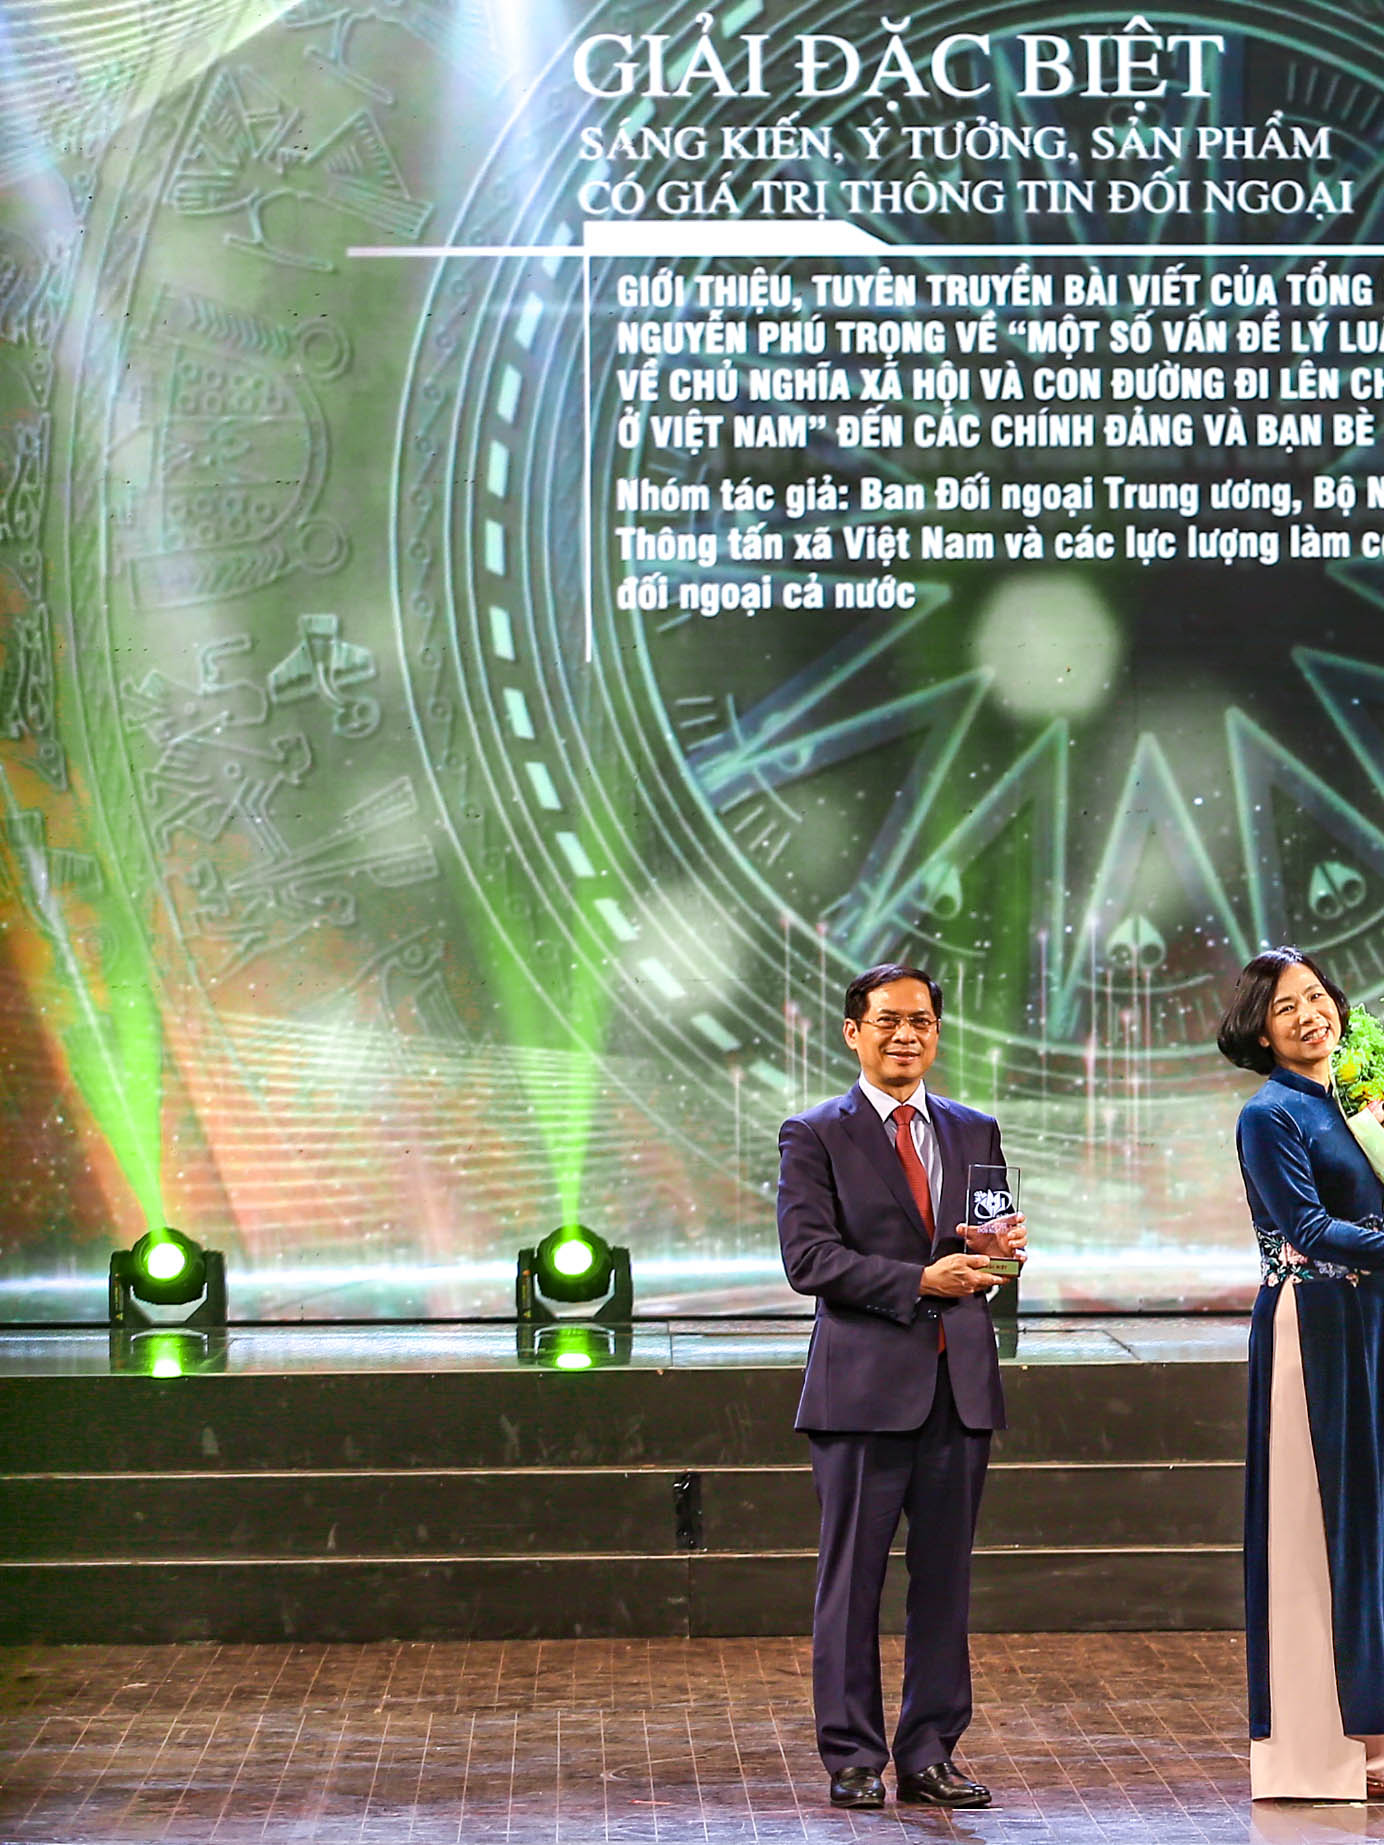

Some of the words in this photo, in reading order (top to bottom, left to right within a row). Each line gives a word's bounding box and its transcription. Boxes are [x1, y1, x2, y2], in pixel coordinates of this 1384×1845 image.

[572, 11, 769, 98] GIẢI
[795, 16, 990, 111] ĐẶC
[1017, 15, 1224, 111] BIỆT
[578, 117, 707, 161] SÁNG
[721, 111, 843, 163] KIẾN,
[857, 117, 889, 159] Ý
[901, 116, 1078, 165] TƯỞNG,
[1092, 116, 1183, 160] SẢN
[1198, 110, 1330, 159] PHẨM
[578, 171, 645, 215] CÓ
[657, 171, 740, 214] GIÁ
[752, 180, 828, 220] TRỊ
[840, 171, 1004, 214] THÔNG
[1017, 180, 1094, 213] TIN
[1109, 166, 1189, 214] ĐỐI
[1204, 180, 1352, 220] NGOẠI
[617, 267, 685, 308] GIỚI
[693, 266, 802, 314] THIỆU,
[811, 267, 916, 307] TUYÊN
[926, 263, 1052, 307] TRUYỀN
[1065, 266, 1117, 306] BÀI
[1128, 263, 1201, 306] VIẾT
[1211, 264, 1277, 306] CỦA
[1286, 260, 1372, 306] TỔNG
[617, 309, 746, 354] NGUYỄN
[759, 314, 825, 354] PHÚ
[835, 321, 945, 360] TRỌNG
[955, 309, 997, 353] VỀ
[1008, 313, 1100, 360] “MỘT
[1110, 309, 1153, 353] SỐ
[1162, 309, 1226, 352] VẤN
[1236, 309, 1280, 352] ĐỀ
[1292, 313, 1329, 352] LÝ
[617, 358, 658, 401] VỀ
[669, 358, 738, 401] CHỦ
[749, 361, 850, 401] NGHĨA
[860, 361, 902, 400] XÃ
[913, 360, 969, 408] HỘI
[980, 360, 1023, 399] VÀ
[1034, 368, 1100, 400] CON
[1110, 360, 1224, 400] ĐƯỜNG
[1234, 368, 1268, 399] ĐI
[1280, 359, 1339, 399] LÊN
[618, 406, 641, 448] Ở
[650, 408, 724, 455] VIỆT
[734, 415, 826, 447] NAM”
[836, 404, 902, 447] ĐẾN
[914, 407, 980, 447] CÁC
[991, 407, 1093, 447] CHÍNH
[1103, 406, 1193, 446] ĐẢNG
[1203, 407, 1246, 446] VÀ
[1257, 414, 1321, 453] BẠN
[1334, 407, 1374, 446] BÈ
[617, 477, 709, 511] Nhóm
[720, 477, 774, 511] tác
[786, 474, 848, 518] giả:
[861, 477, 924, 510] Ban
[934, 472, 990, 510] Đối
[1002, 476, 1092, 517] ngoại
[1103, 476, 1198, 516] Trung
[1211, 478, 1301, 516] ương,
[1314, 475, 1355, 516] Bộ
[615, 526, 717, 568] Thông
[727, 522, 783, 560] tấn
[794, 527, 832, 560] xã
[843, 526, 910, 566] Việt
[922, 526, 993, 559] Nam
[1004, 525, 1043, 559] và
[1055, 525, 1114, 559] các
[1126, 526, 1175, 565] lực
[1188, 525, 1278, 565] lượng
[1291, 524, 1350, 558] làm
[617, 571, 668, 610] đối
[680, 575, 771, 616] ngoại
[783, 572, 823, 609] cả
[835, 575, 915, 608] nước
